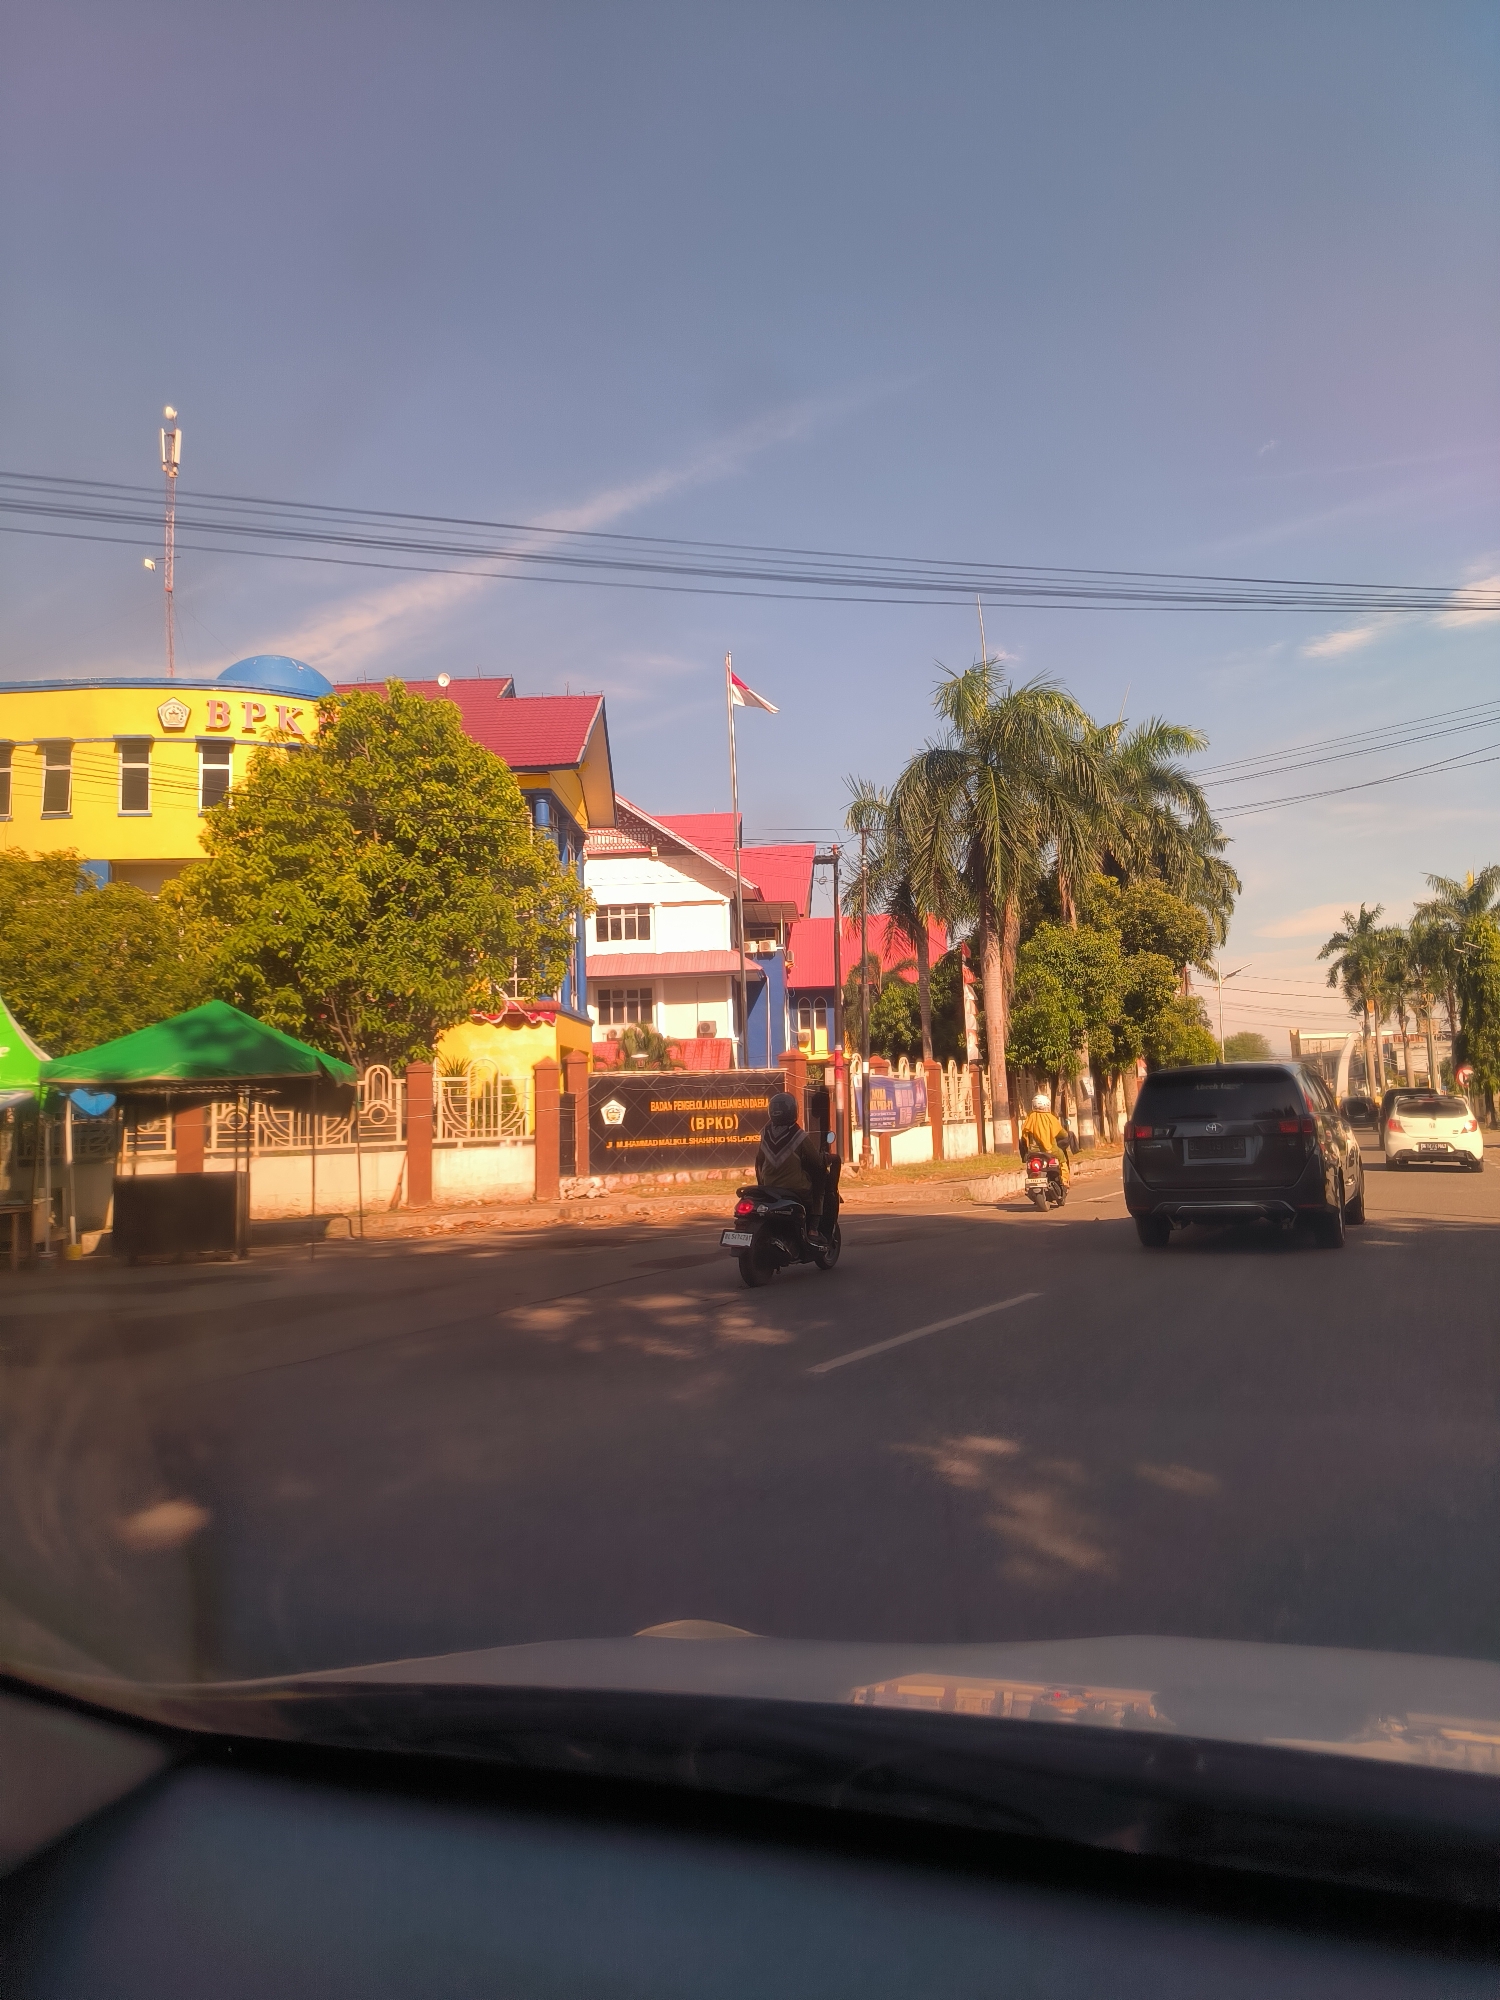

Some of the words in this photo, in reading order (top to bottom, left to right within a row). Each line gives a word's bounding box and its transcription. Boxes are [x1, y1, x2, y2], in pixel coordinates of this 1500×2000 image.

[673, 1100, 718, 1111] PENGELOLAAN
[718, 1098, 749, 1110] KEUANGAN
[750, 1098, 769, 1109] DAERA
[690, 1114, 739, 1131] (BPKD)
